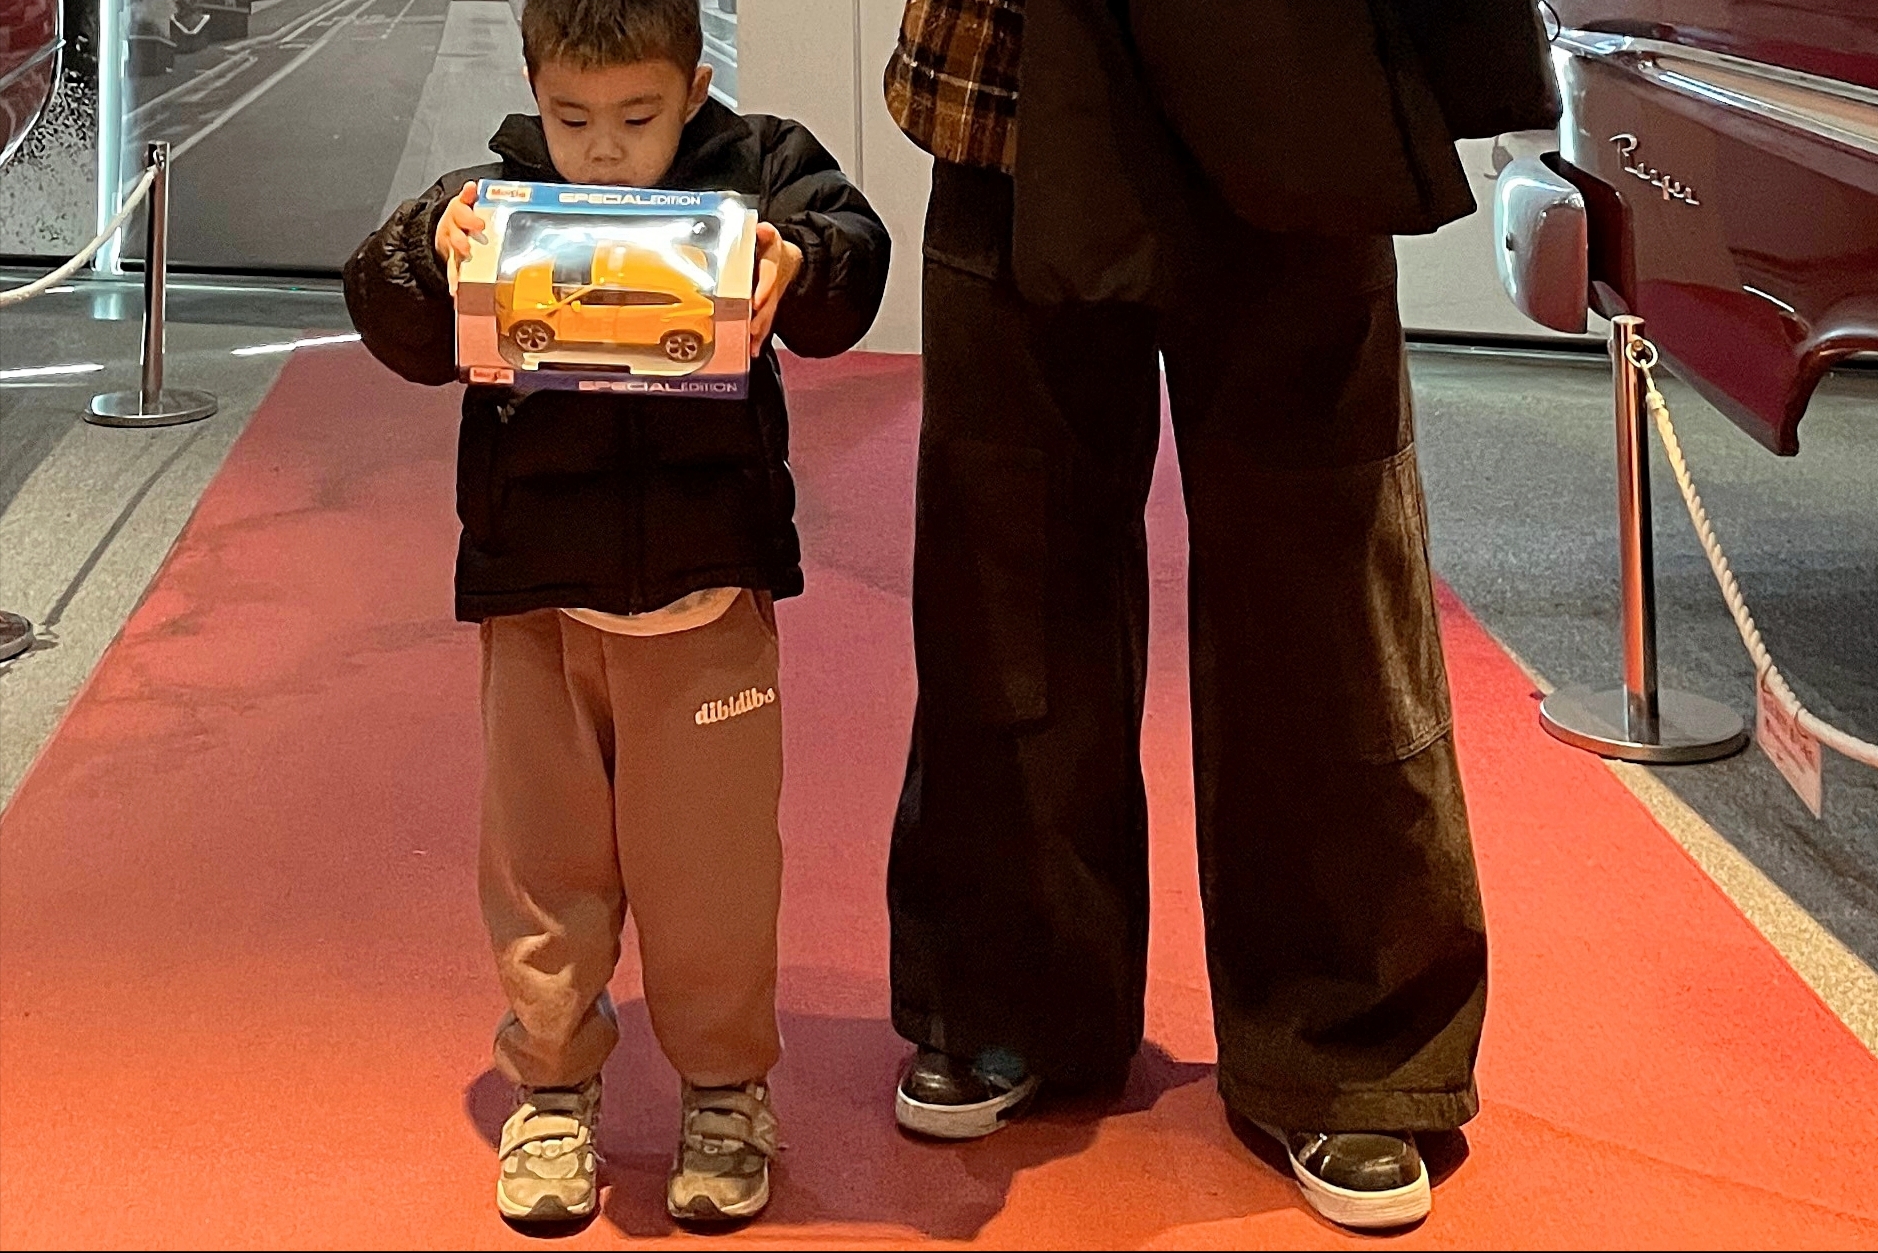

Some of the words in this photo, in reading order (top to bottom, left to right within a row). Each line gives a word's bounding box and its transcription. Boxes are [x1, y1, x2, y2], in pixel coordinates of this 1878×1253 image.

[558, 192, 651, 205] SPECIAL
[651, 194, 701, 206] EDITION
[578, 380, 682, 392] SPECIAL
[682, 381, 738, 393] EDITION
